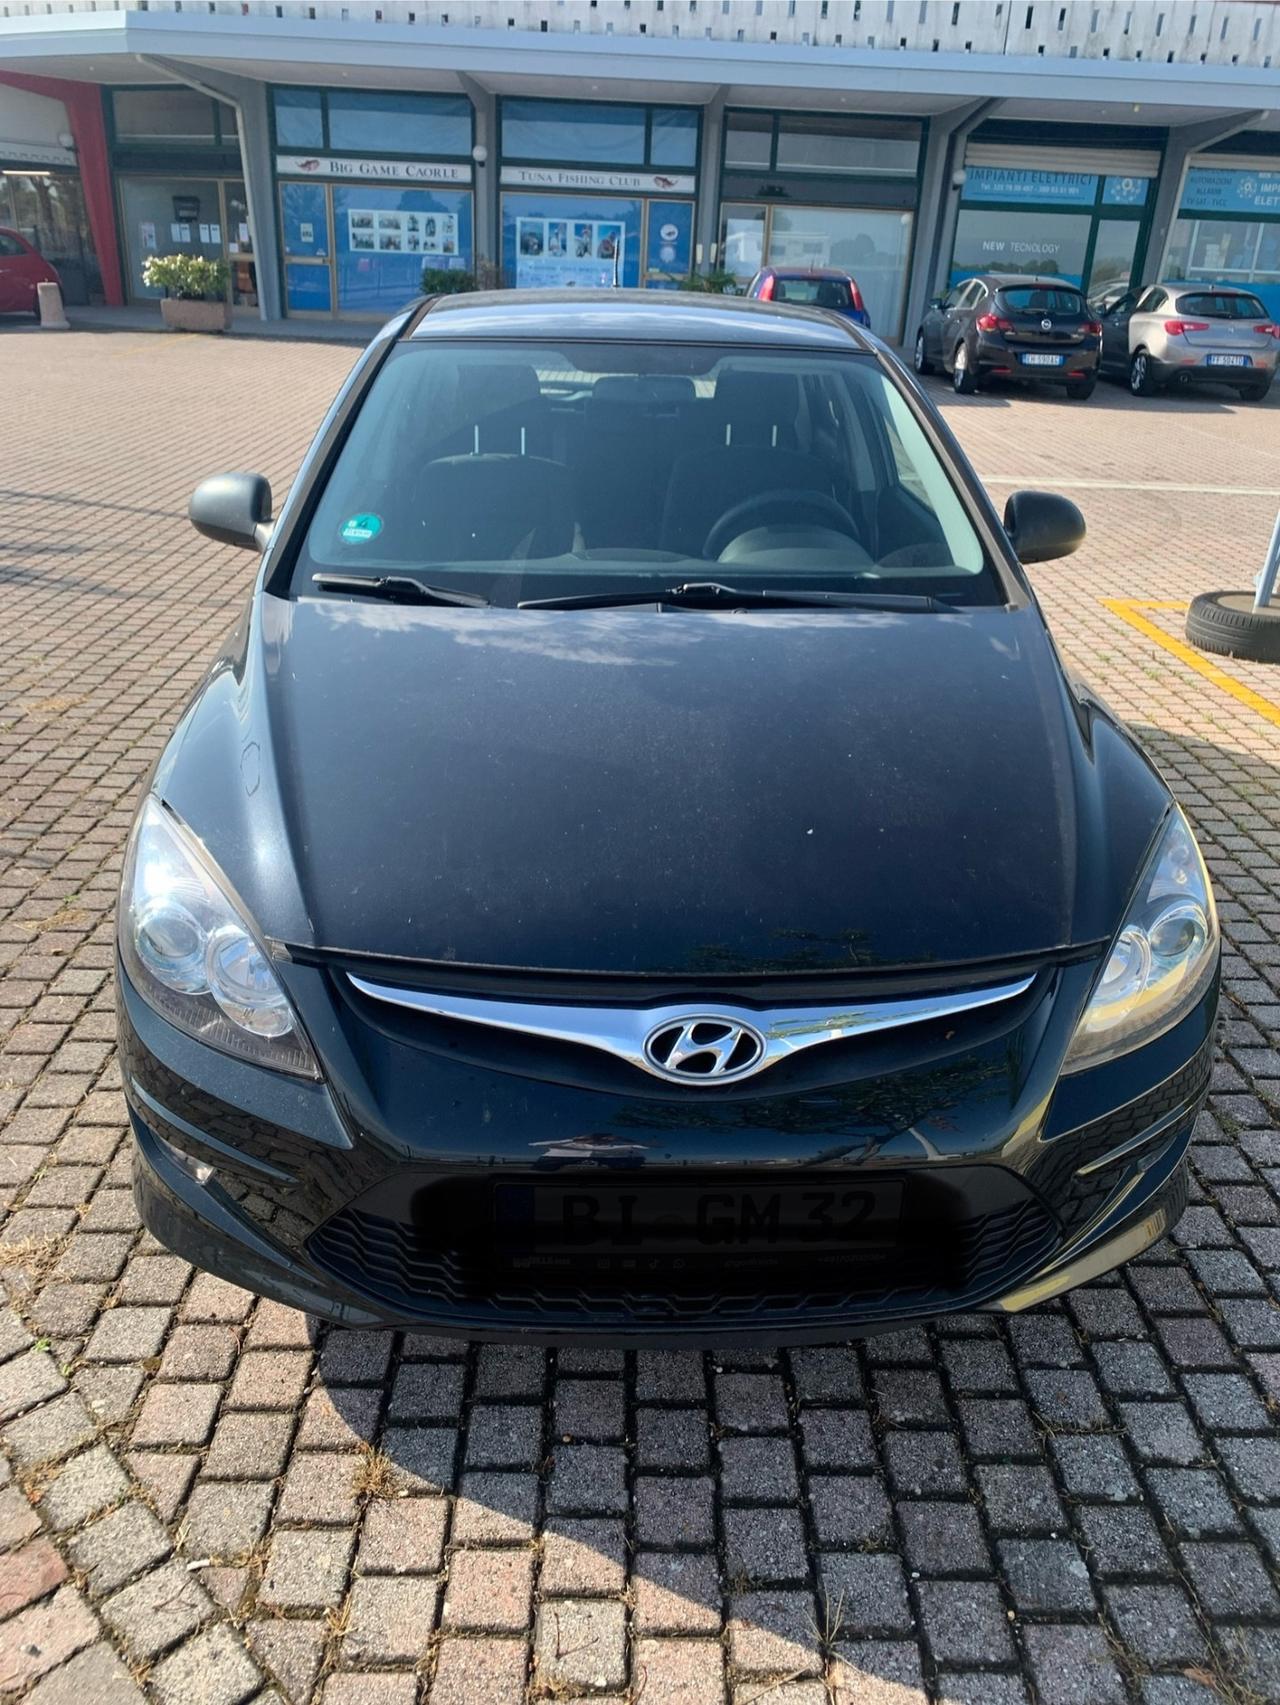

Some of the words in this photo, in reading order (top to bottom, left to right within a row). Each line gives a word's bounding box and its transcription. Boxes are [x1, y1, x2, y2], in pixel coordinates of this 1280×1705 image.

[329, 160, 353, 174] BIG
[359, 162, 399, 177] GAME
[405, 165, 459, 179] CAORLE
[969, 168, 1027, 182] IMPIANTI
[1031, 171, 1093, 186] ELETTRICI
[518, 171, 553, 183] TUNA
[558, 173, 605, 186] FISHING
[609, 176, 641, 187] CLUB
[982, 240, 1005, 251] NEW
[1010, 241, 1060, 254] TECNOLOGY
[804, 1190, 878, 1243] 32
